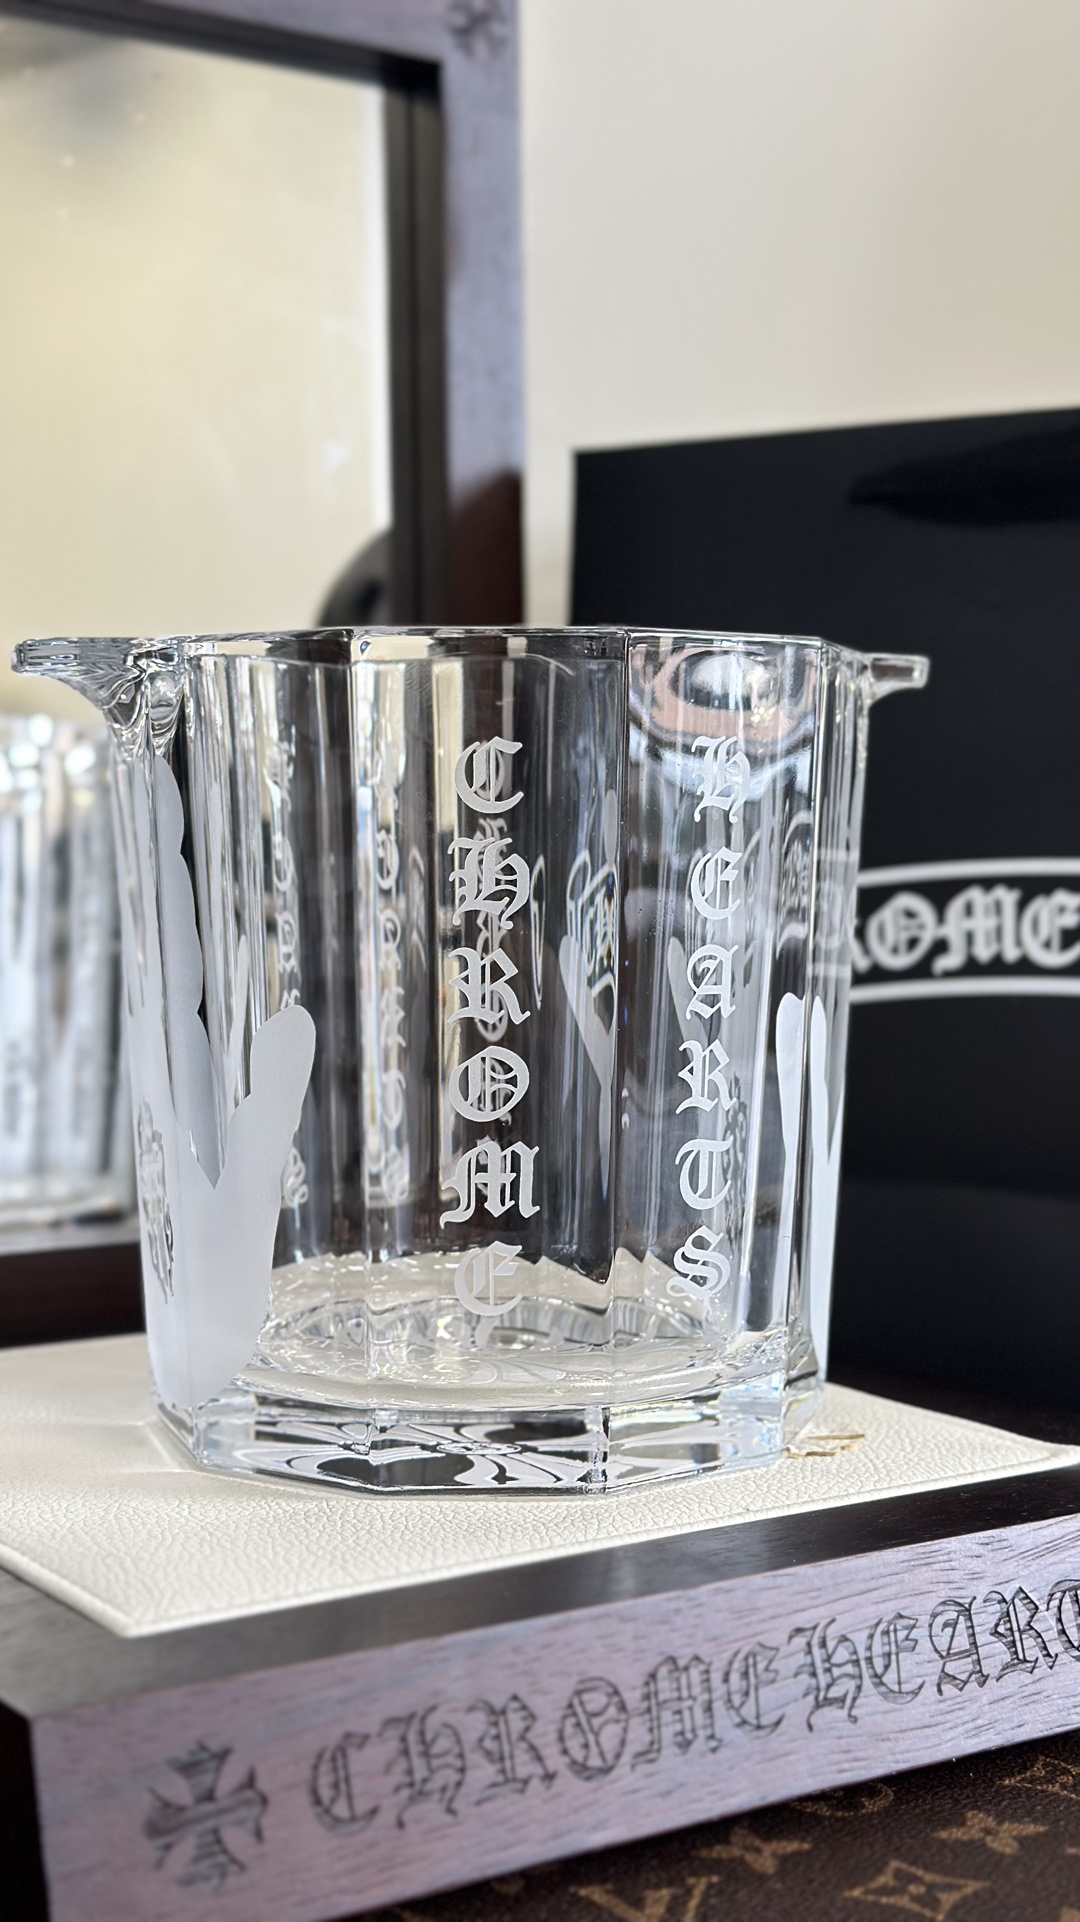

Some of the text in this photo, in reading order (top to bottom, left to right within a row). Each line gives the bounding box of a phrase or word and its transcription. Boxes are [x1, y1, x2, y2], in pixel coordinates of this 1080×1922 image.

[438, 736, 540, 1317] CHROME
[666, 735, 751, 1300] HEARTS
[309, 1642, 786, 1836] CHROME
